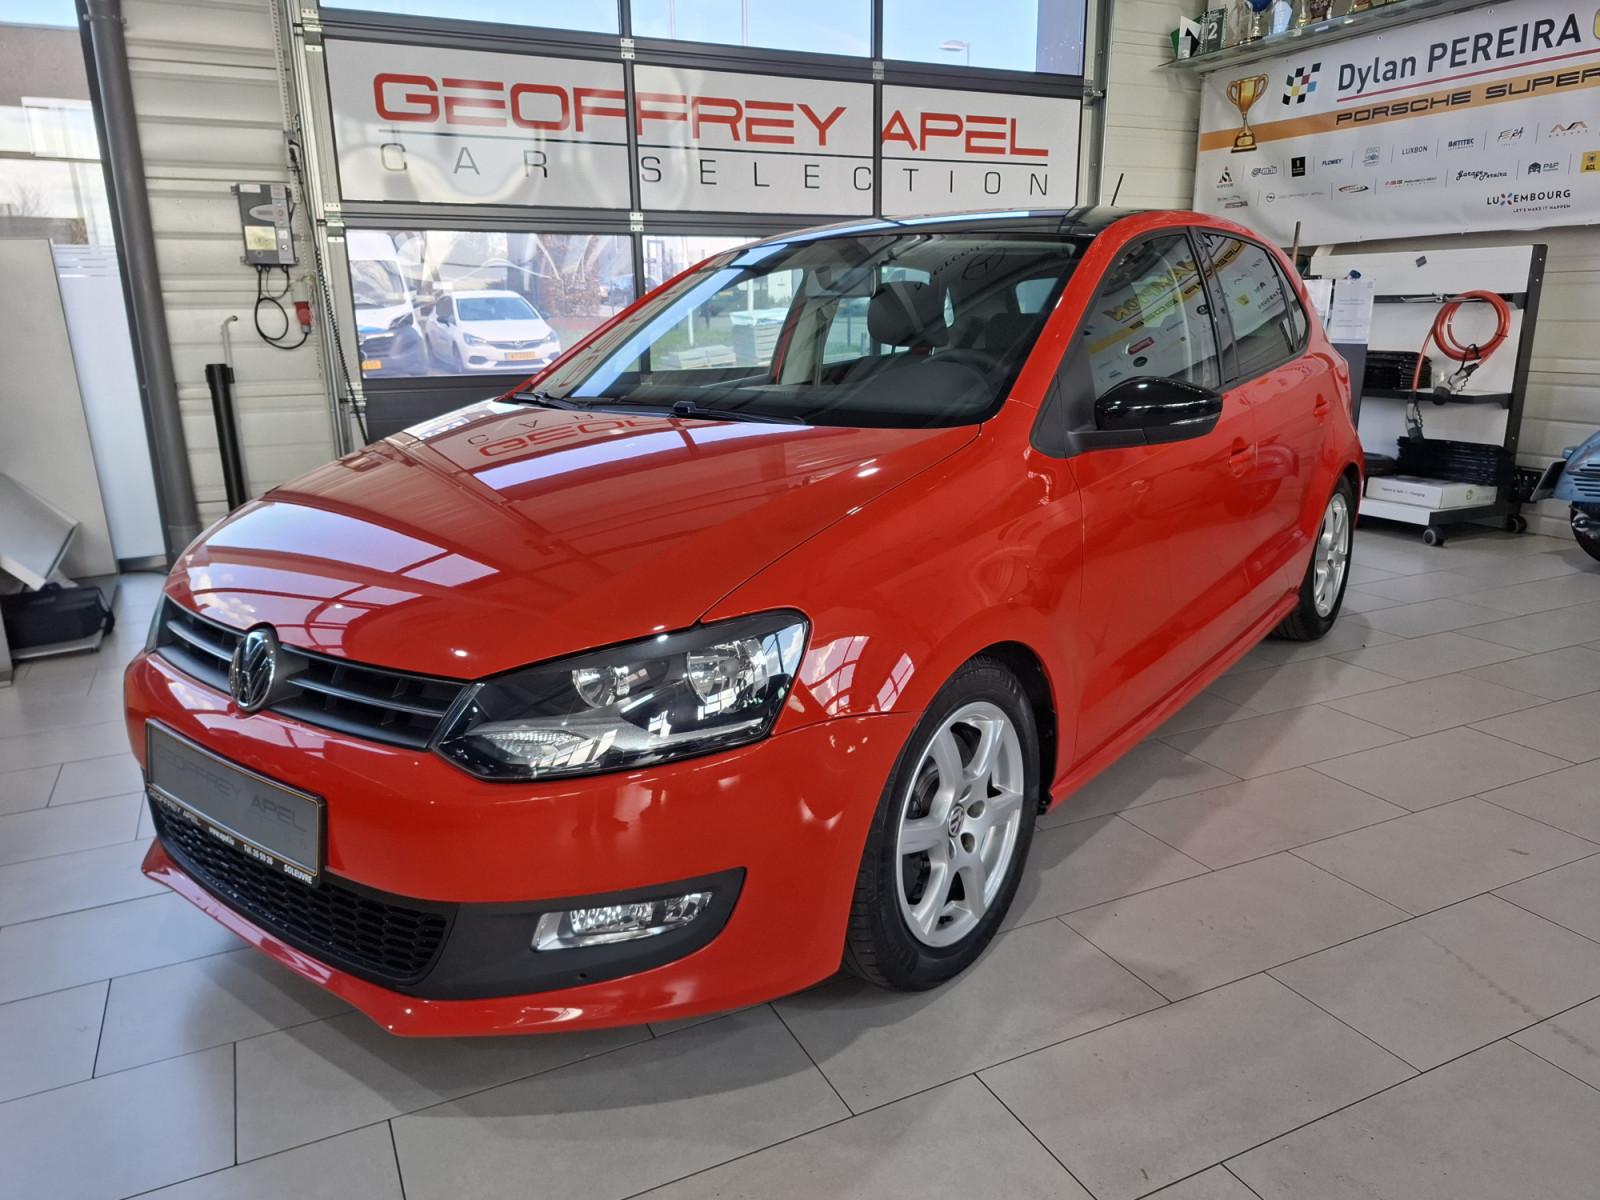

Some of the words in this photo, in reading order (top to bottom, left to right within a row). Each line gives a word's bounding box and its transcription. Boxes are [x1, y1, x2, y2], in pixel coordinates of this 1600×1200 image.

[1338, 56, 1417, 94] Dylan
[1427, 13, 1582, 73] PEREIRA
[373, 72, 846, 147] GEOFFREY
[882, 110, 1049, 157] APEL
[1336, 90, 1472, 126] PORSCHE
[380, 143, 548, 179] CAR
[640, 156, 1049, 197] SELECTION
[1487, 189, 1571, 206] LUXEMBOURG
[283, 864, 313, 885] SOLEUVRE
